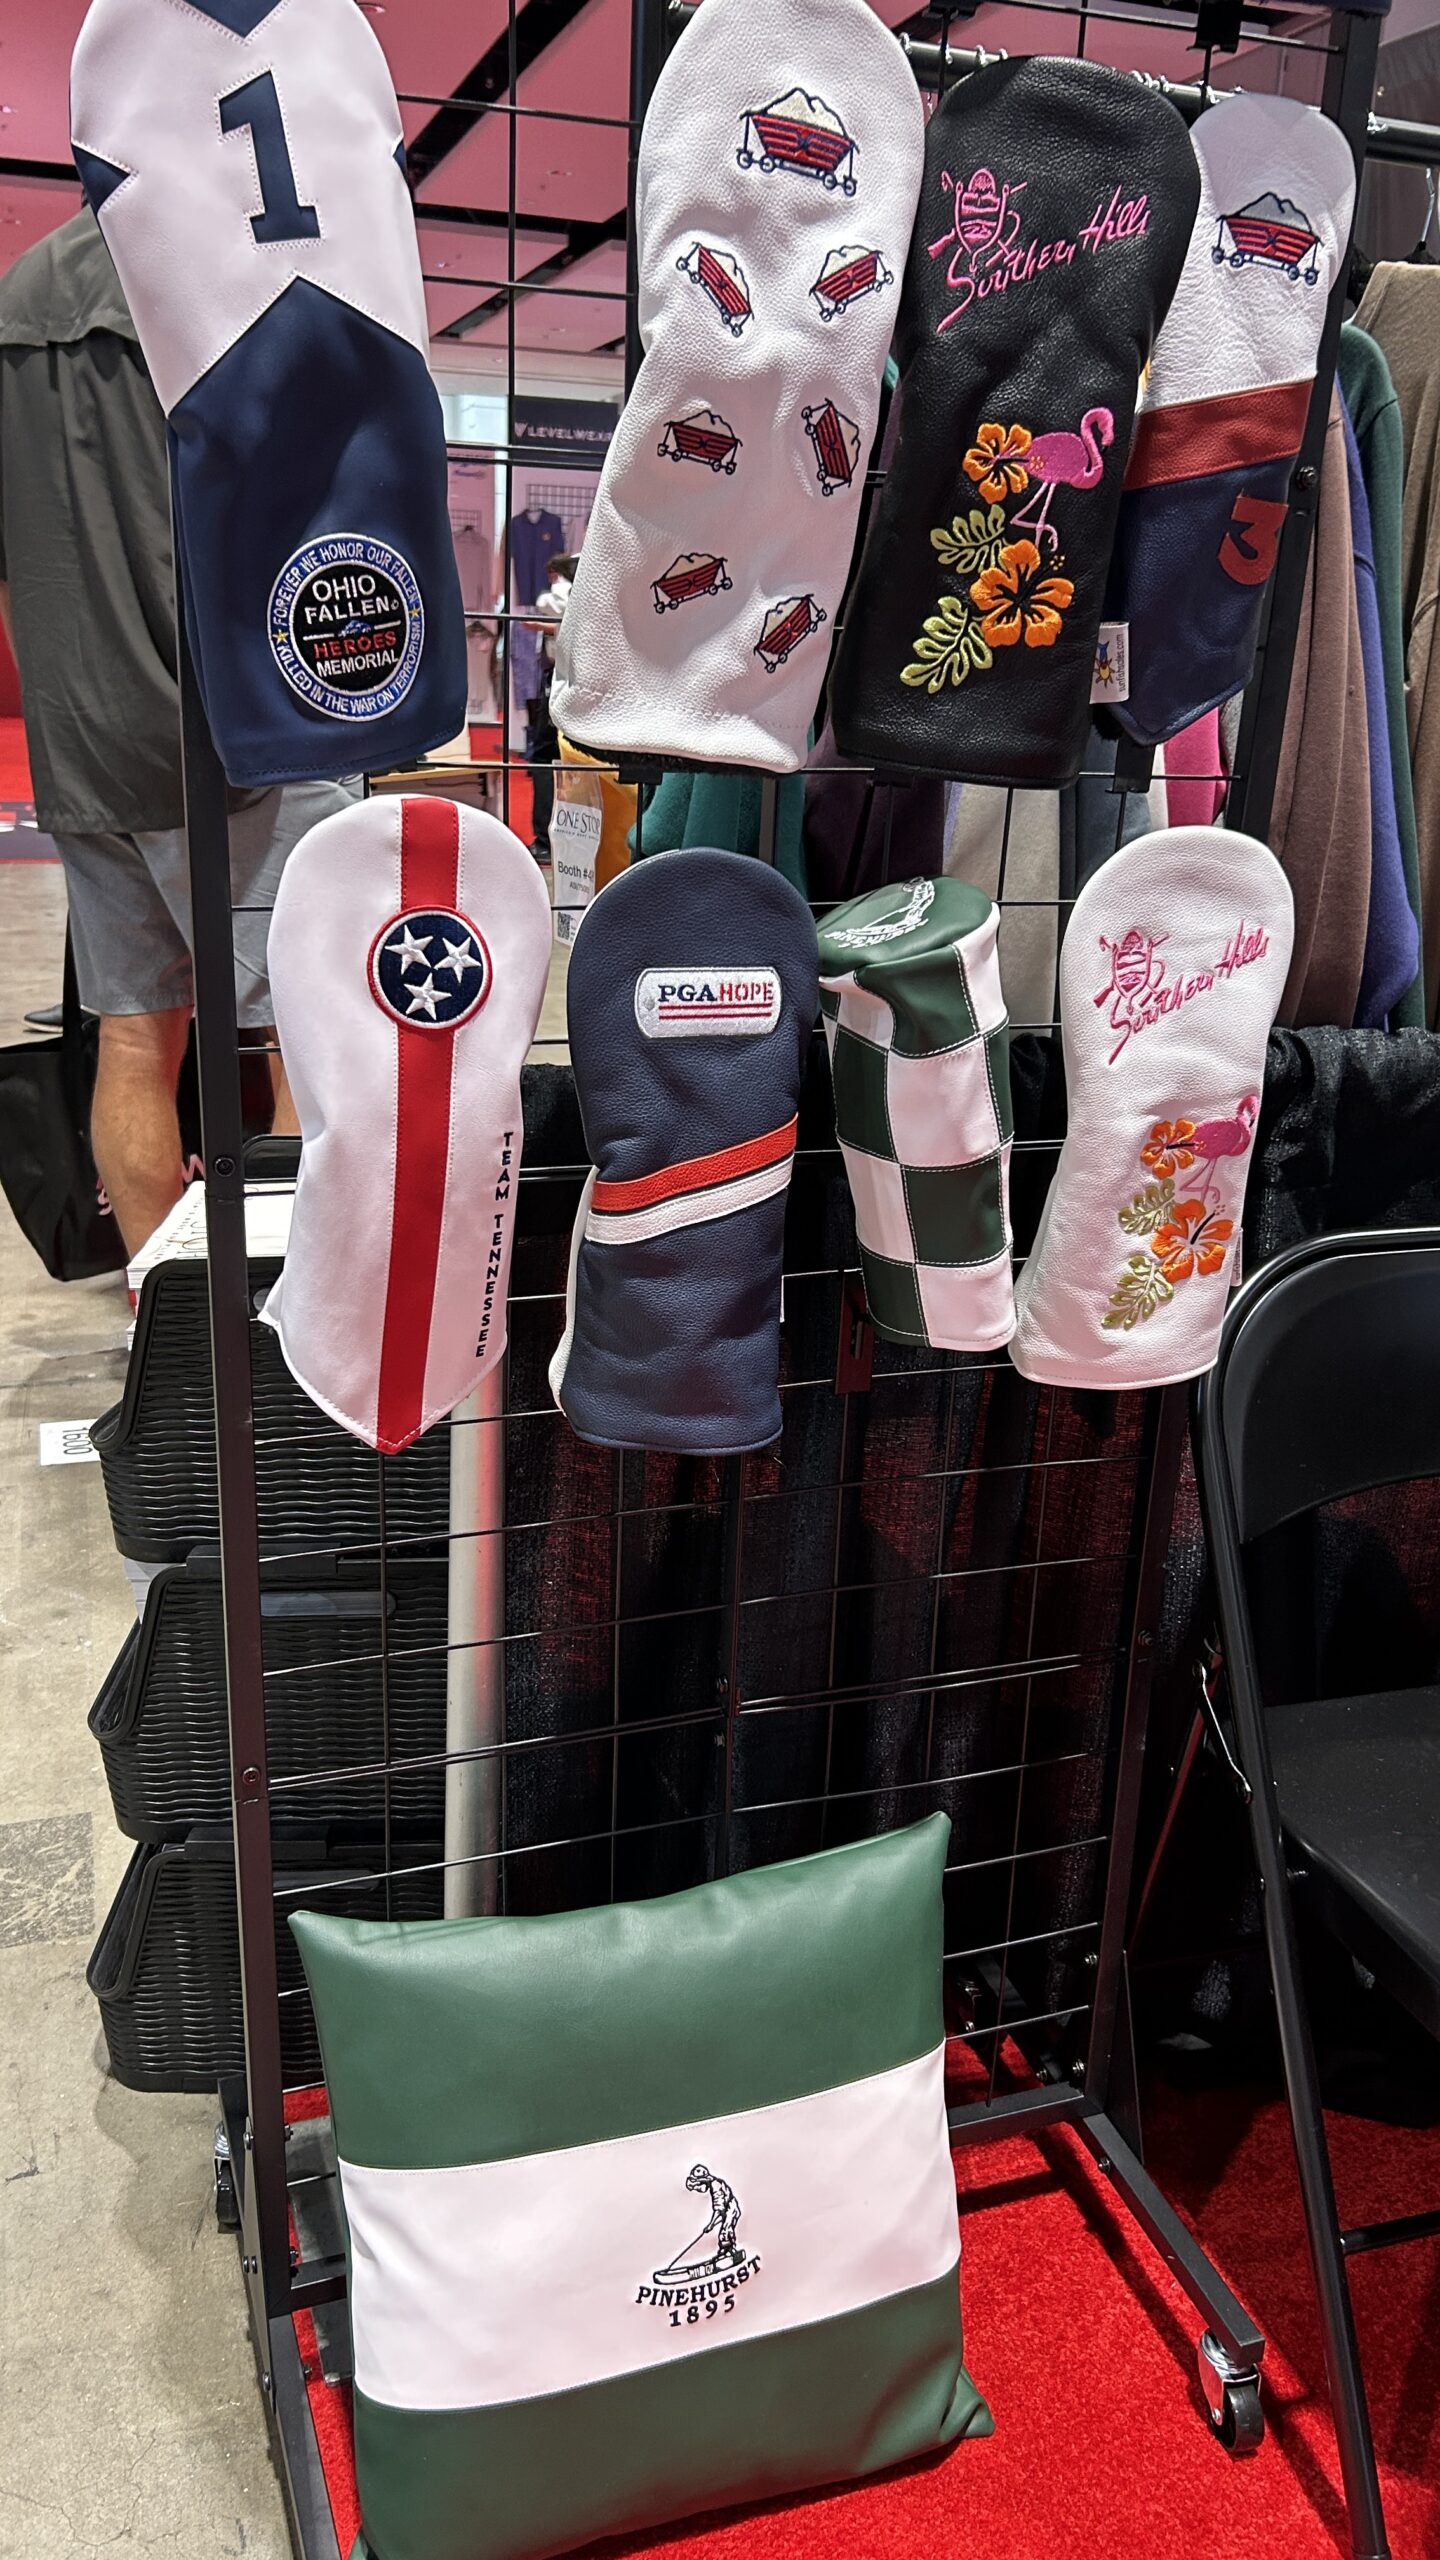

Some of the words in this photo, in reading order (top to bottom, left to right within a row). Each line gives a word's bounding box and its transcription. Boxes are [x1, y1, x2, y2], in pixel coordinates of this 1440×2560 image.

[219, 70, 321, 244] 1
[936, 238, 1076, 334] Southern
[1079, 185, 1151, 254] Hills
[1216, 495, 1289, 586] 3
[273, 568, 302, 627] FOREVER
[302, 550, 322, 573] WE
[320, 543, 364, 562] HONOR
[367, 546, 392, 568] OUR
[390, 562, 420, 604] FALLEN
[312, 575, 376, 602] OHIO
[277, 644, 313, 692] KILLED
[310, 686, 324, 703] IN
[325, 692, 350, 714] THE
[350, 693, 377, 715] WAR
[376, 689, 396, 708] ON
[394, 620, 422, 697] TERRORISM
[313, 631, 398, 659] HEROES
[316, 649, 401, 678] MEMORIAL
[557, 809, 579, 830] ONE
[558, 860, 582, 878] Booth
[657, 983, 717, 1002] PGA
[719, 981, 774, 1002] HOPE
[1108, 974, 1214, 1065] Southern
[1214, 918, 1269, 978] Hills
[495, 1131, 514, 1201] TEAM
[475, 1213, 504, 1358] TENNESSEE
[635, 2255, 762, 2307] PINEHURST
[669, 2294, 736, 2328] 1895
